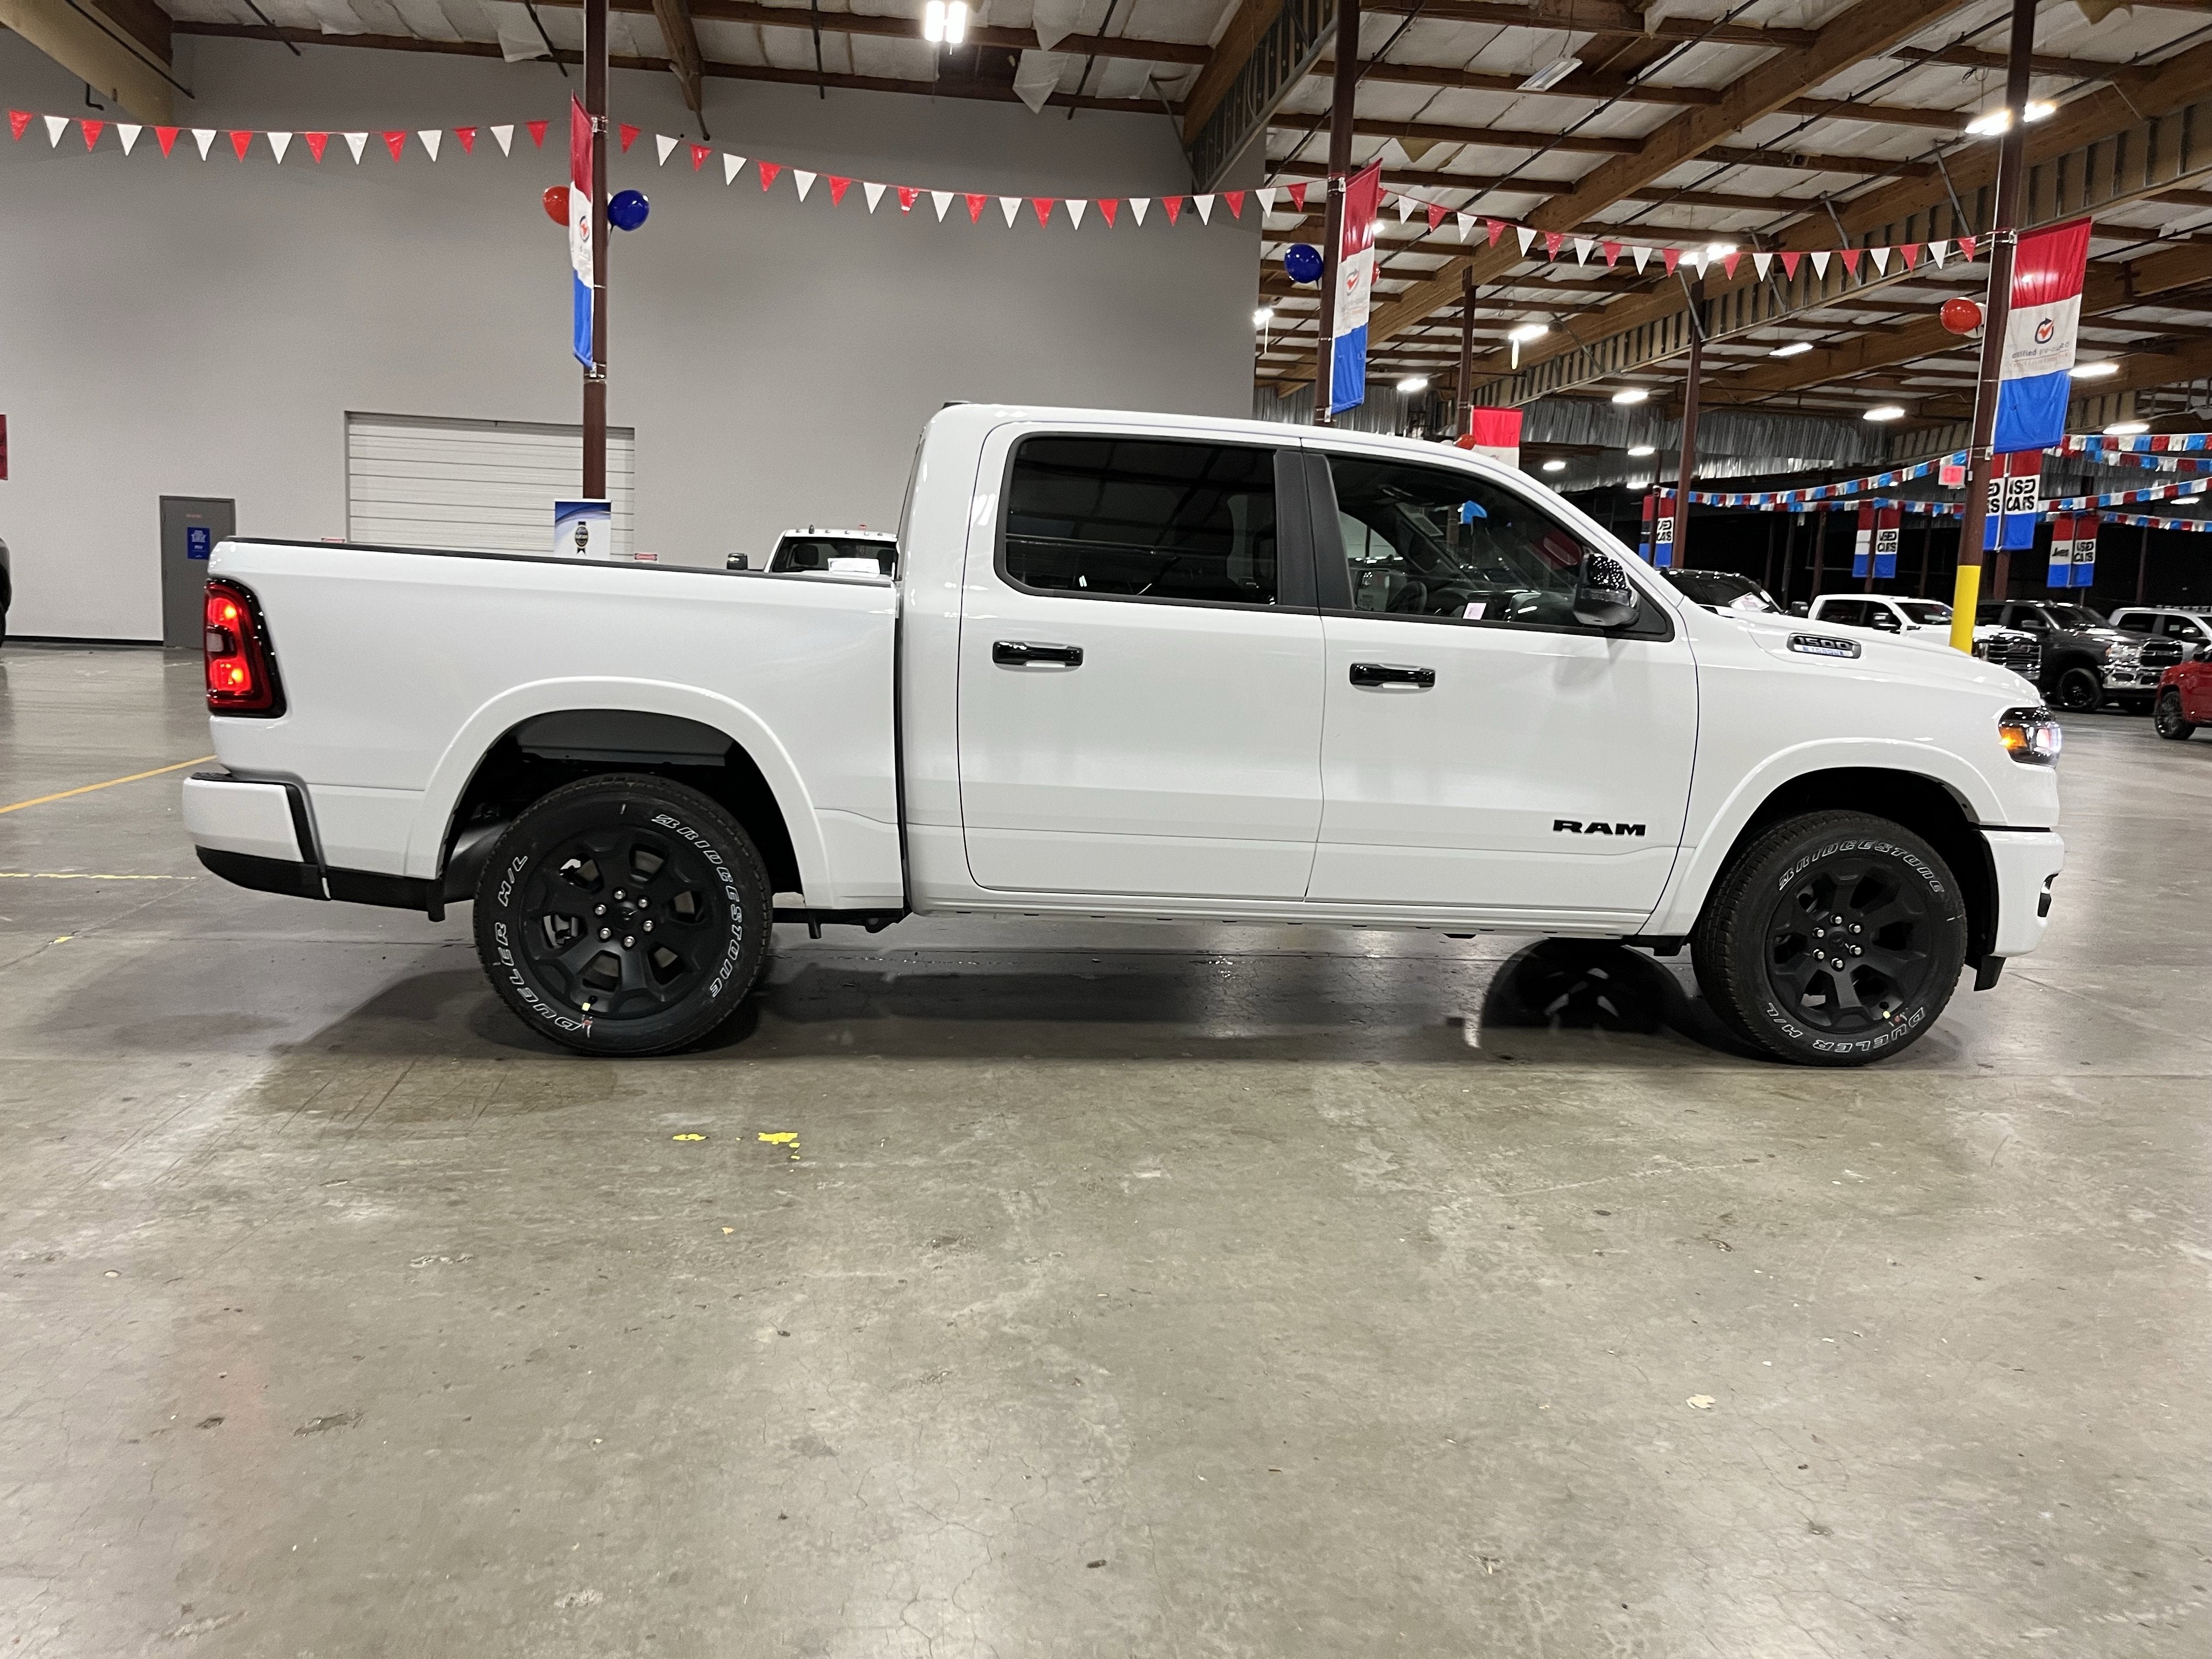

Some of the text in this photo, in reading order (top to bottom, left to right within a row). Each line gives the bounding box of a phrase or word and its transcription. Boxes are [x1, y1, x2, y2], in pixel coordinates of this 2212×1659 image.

[1797, 636, 1850, 650] 1500
[1553, 819, 1646, 837] RAM
[1779, 839, 1944, 891] BRIDGESTONE
[651, 814, 743, 998] BRIDGESTONE
[494, 922, 583, 1031] DUELER
[1813, 1007, 1925, 1053] DUELER
